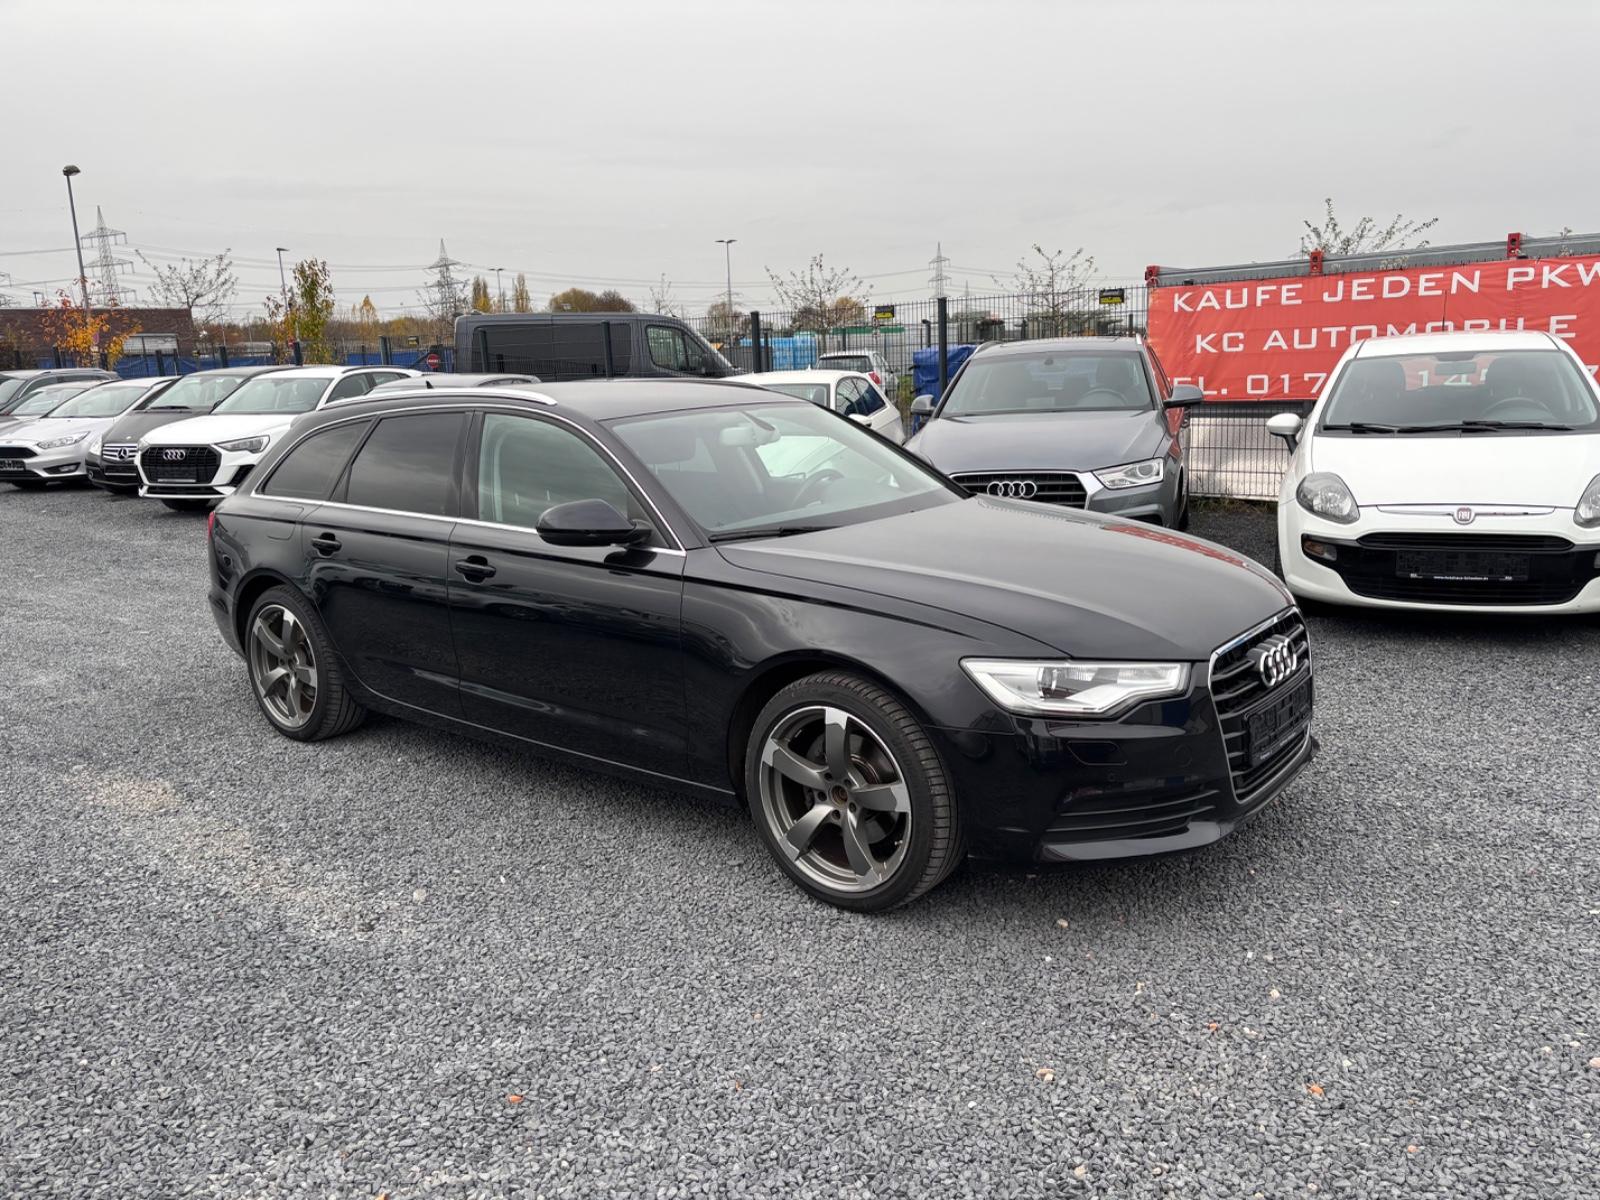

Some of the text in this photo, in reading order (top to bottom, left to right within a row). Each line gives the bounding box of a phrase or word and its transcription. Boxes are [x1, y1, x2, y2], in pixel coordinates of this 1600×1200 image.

[1173, 262, 1600, 313] KAUFE JEDEN PKW
[1195, 331, 1245, 354] KC
